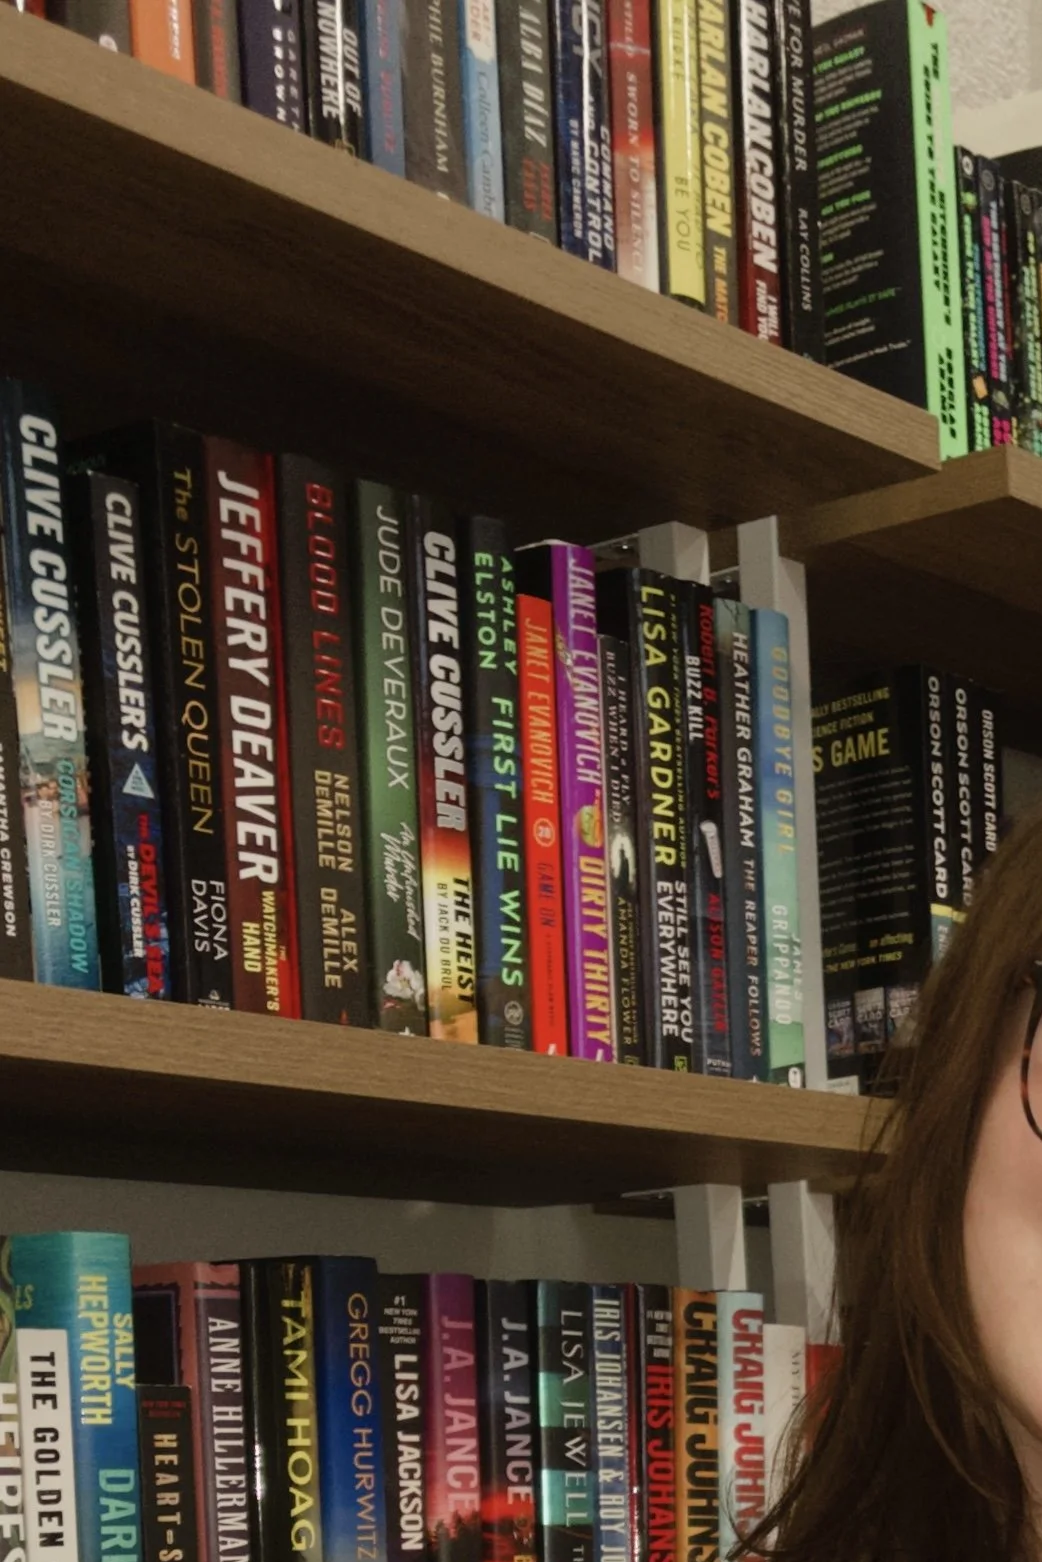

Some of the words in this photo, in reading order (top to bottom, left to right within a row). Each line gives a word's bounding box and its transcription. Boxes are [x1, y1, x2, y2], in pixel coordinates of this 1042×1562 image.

[789, 35, 804, 68] FOR
[927, 42, 940, 81] THE
[431, 53, 449, 173] BURNHAM
[626, 71, 640, 154] SWORN
[791, 78, 808, 171] MURDER
[572, 168, 583, 239] CAMERON
[599, 125, 614, 251] COMMAND
[629, 155, 641, 183] TO
[675, 176, 690, 199] BE
[702, 121, 732, 237] COBEN
[677, 205, 691, 252] YOU
[749, 151, 778, 275] COBEN
[798, 208, 811, 241] RAY
[713, 246, 727, 275] THE
[799, 243, 812, 312] COLLINS
[19, 413, 65, 545] CLIVE
[105, 491, 137, 585] CLIVE
[217, 469, 270, 687] JEFFERY
[376, 505, 402, 598] JUDE
[175, 533, 206, 690] STOLEN
[423, 530, 460, 650] CLIVE
[474, 551, 497, 670] ELSTON
[500, 555, 517, 676] ASHLEY
[29, 548, 78, 743] CUSSLER
[380, 606, 410, 790] DEVERAUX
[571, 651, 603, 787] EVANOVICH
[928, 675, 943, 758] ORSON
[954, 687, 970, 769] ORSON
[981, 709, 995, 759] ORSON
[181, 699, 214, 836] QUEEN
[429, 653, 467, 832] CUSSLER
[491, 695, 517, 800] FIRST
[527, 689, 554, 806] EVANOVICH
[230, 694, 279, 885] DEAVER
[332, 772, 354, 873] NELSON
[736, 746, 755, 849] GRAHAM
[930, 761, 947, 840] SCOTT
[957, 772, 973, 850] SCOTT
[981, 760, 997, 809] SCOTT
[496, 812, 519, 873] LIE
[934, 842, 949, 899] CARD
[984, 811, 997, 852] CARD
[4, 849, 17, 938] CREWSON
[42, 863, 61, 928] CUSSLER
[191, 878, 211, 954] DAVIS
[437, 882, 448, 899] BY
[675, 880, 688, 939] STILL
[743, 858, 756, 892] THE
[208, 879, 229, 961] FIONA
[339, 908, 359, 974] ALEX
[438, 902, 450, 933] JACK
[499, 888, 524, 988] WINS
[617, 896, 629, 971] AMANDA
[745, 899, 759, 967] REAPER
[677, 946, 691, 988] SEE
[621, 976, 633, 1046] FLOWER
[680, 996, 694, 1045] YOU
[748, 974, 762, 1057] FOLLOWS
[30, 1351, 58, 1411] THE
[77, 1275, 113, 1426] HEPWORTH
[112, 1312, 136, 1391] SALLY
[207, 1316, 242, 1394] ANNE
[347, 1292, 372, 1418] GREGG
[394, 1353, 420, 1421] LISA
[560, 1309, 584, 1385] LISA
[33, 1426, 66, 1549] GOLDEN
[285, 1417, 317, 1552] HOAG
[444, 1393, 482, 1513] JANCE
[504, 1390, 535, 1505] JANCE
[352, 1427, 378, 1562] HURWITZ
[396, 1430, 424, 1551] JACKSON
